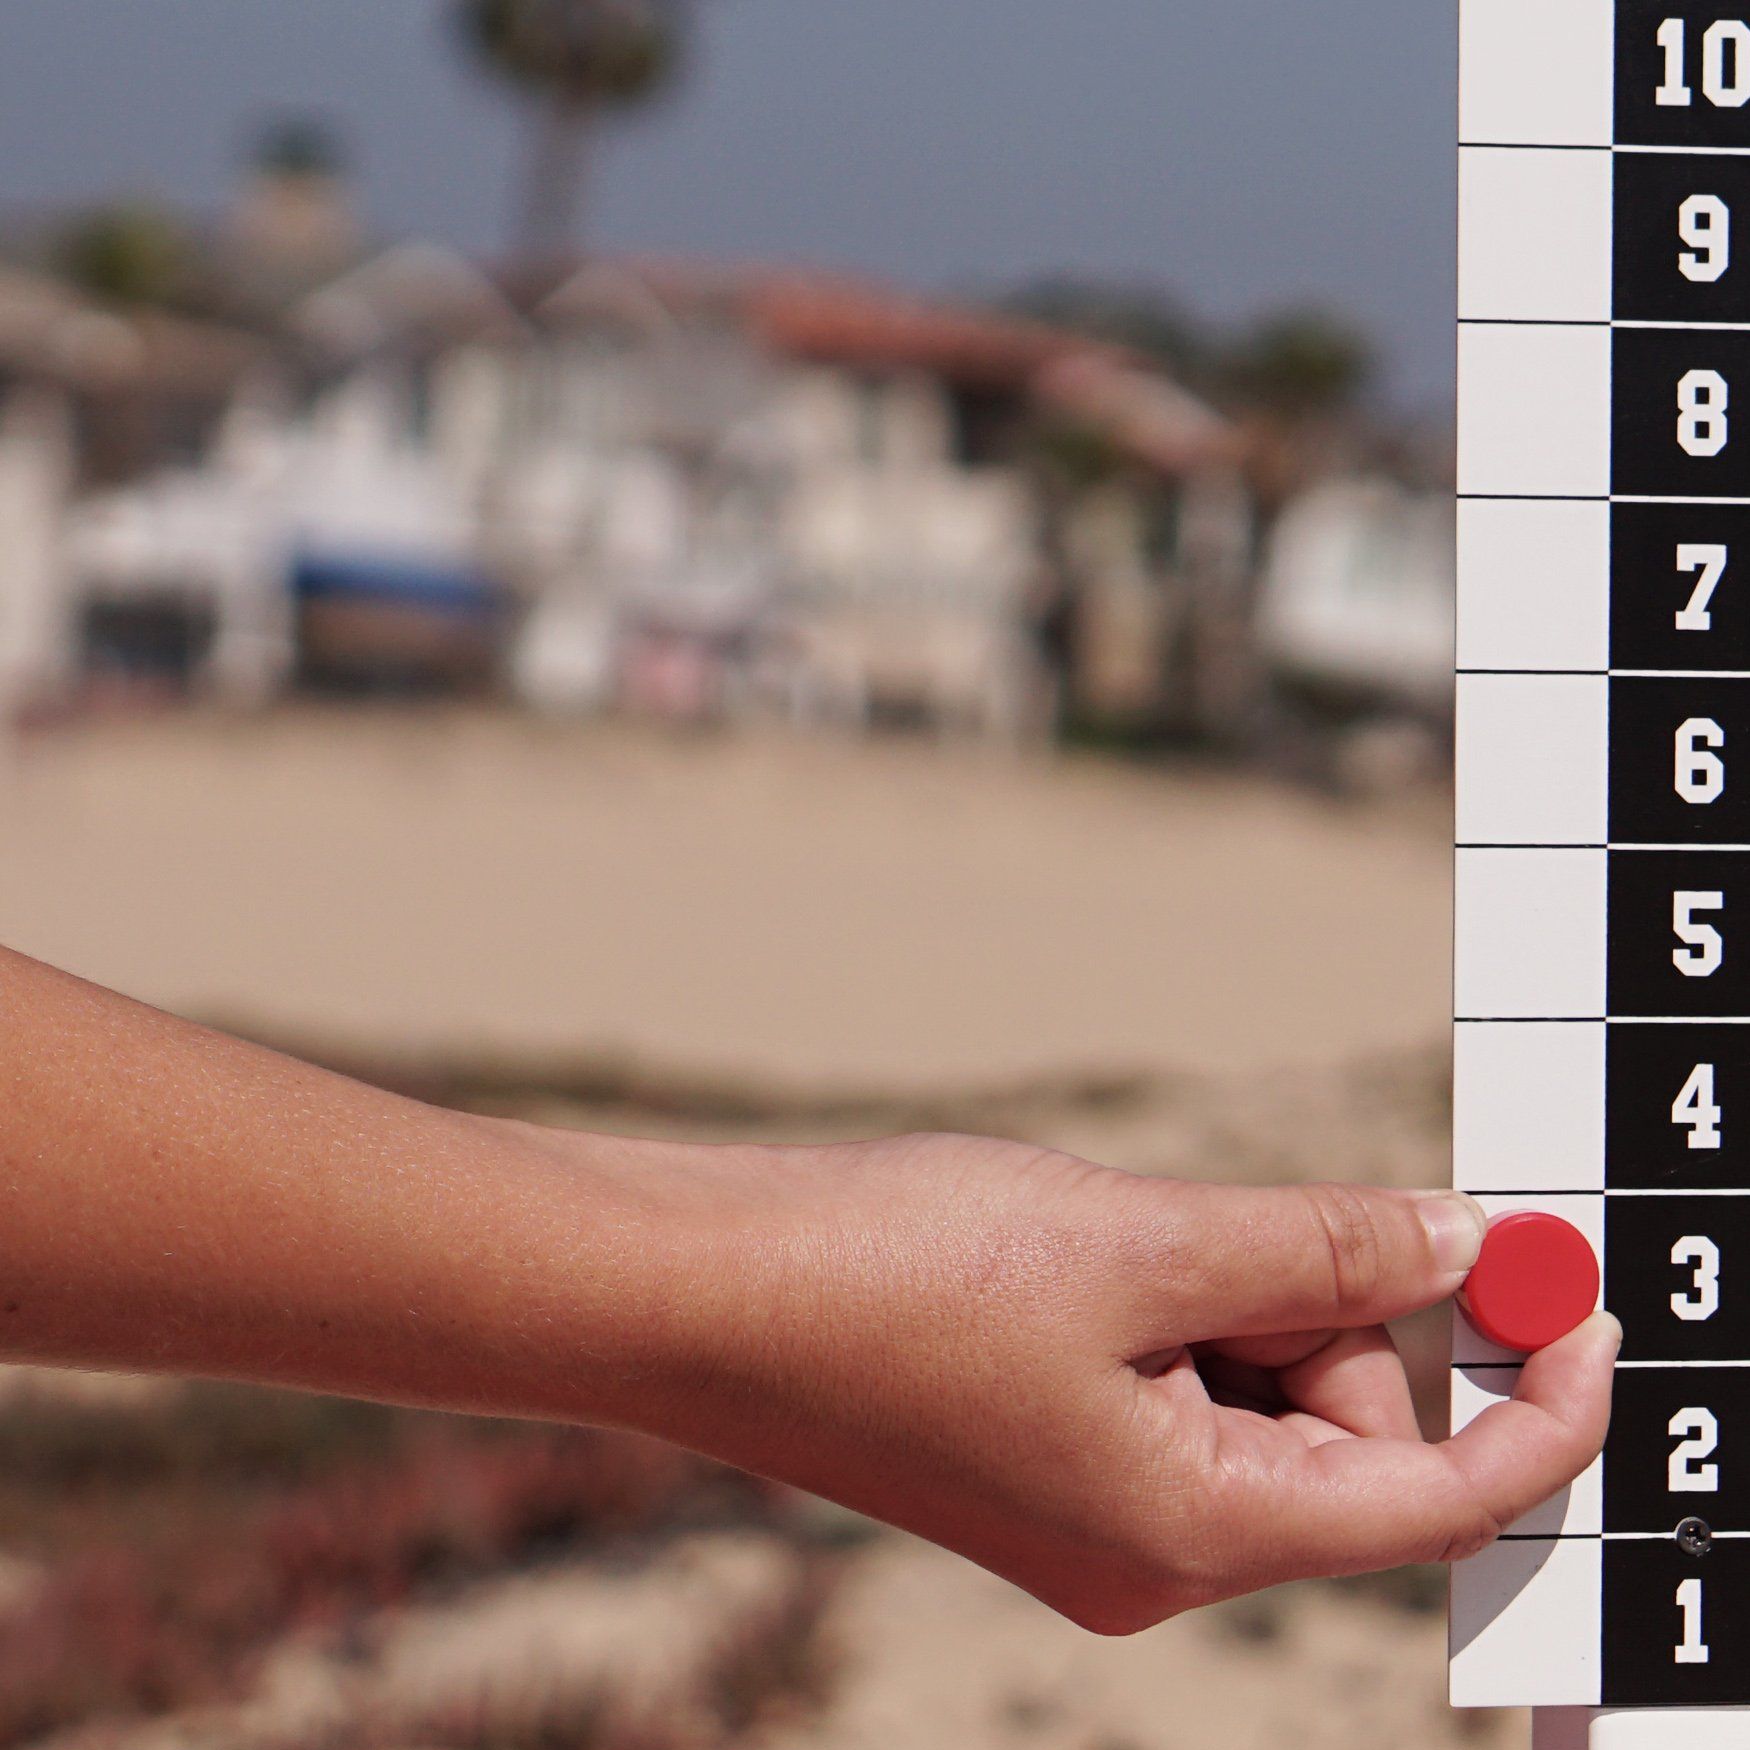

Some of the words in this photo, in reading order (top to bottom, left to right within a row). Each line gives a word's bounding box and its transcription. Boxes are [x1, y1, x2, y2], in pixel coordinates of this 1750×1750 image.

[1678, 194, 1730, 282] 9
[1676, 369, 1728, 457] 8
[1675, 545, 1727, 631] 7
[1674, 717, 1724, 804] 6
[1672, 890, 1723, 977] 5
[1671, 1063, 1721, 1149] 4
[1670, 1235, 1720, 1321] 3
[1668, 1407, 1719, 1492] 2
[1674, 1578, 1709, 1664] 1
